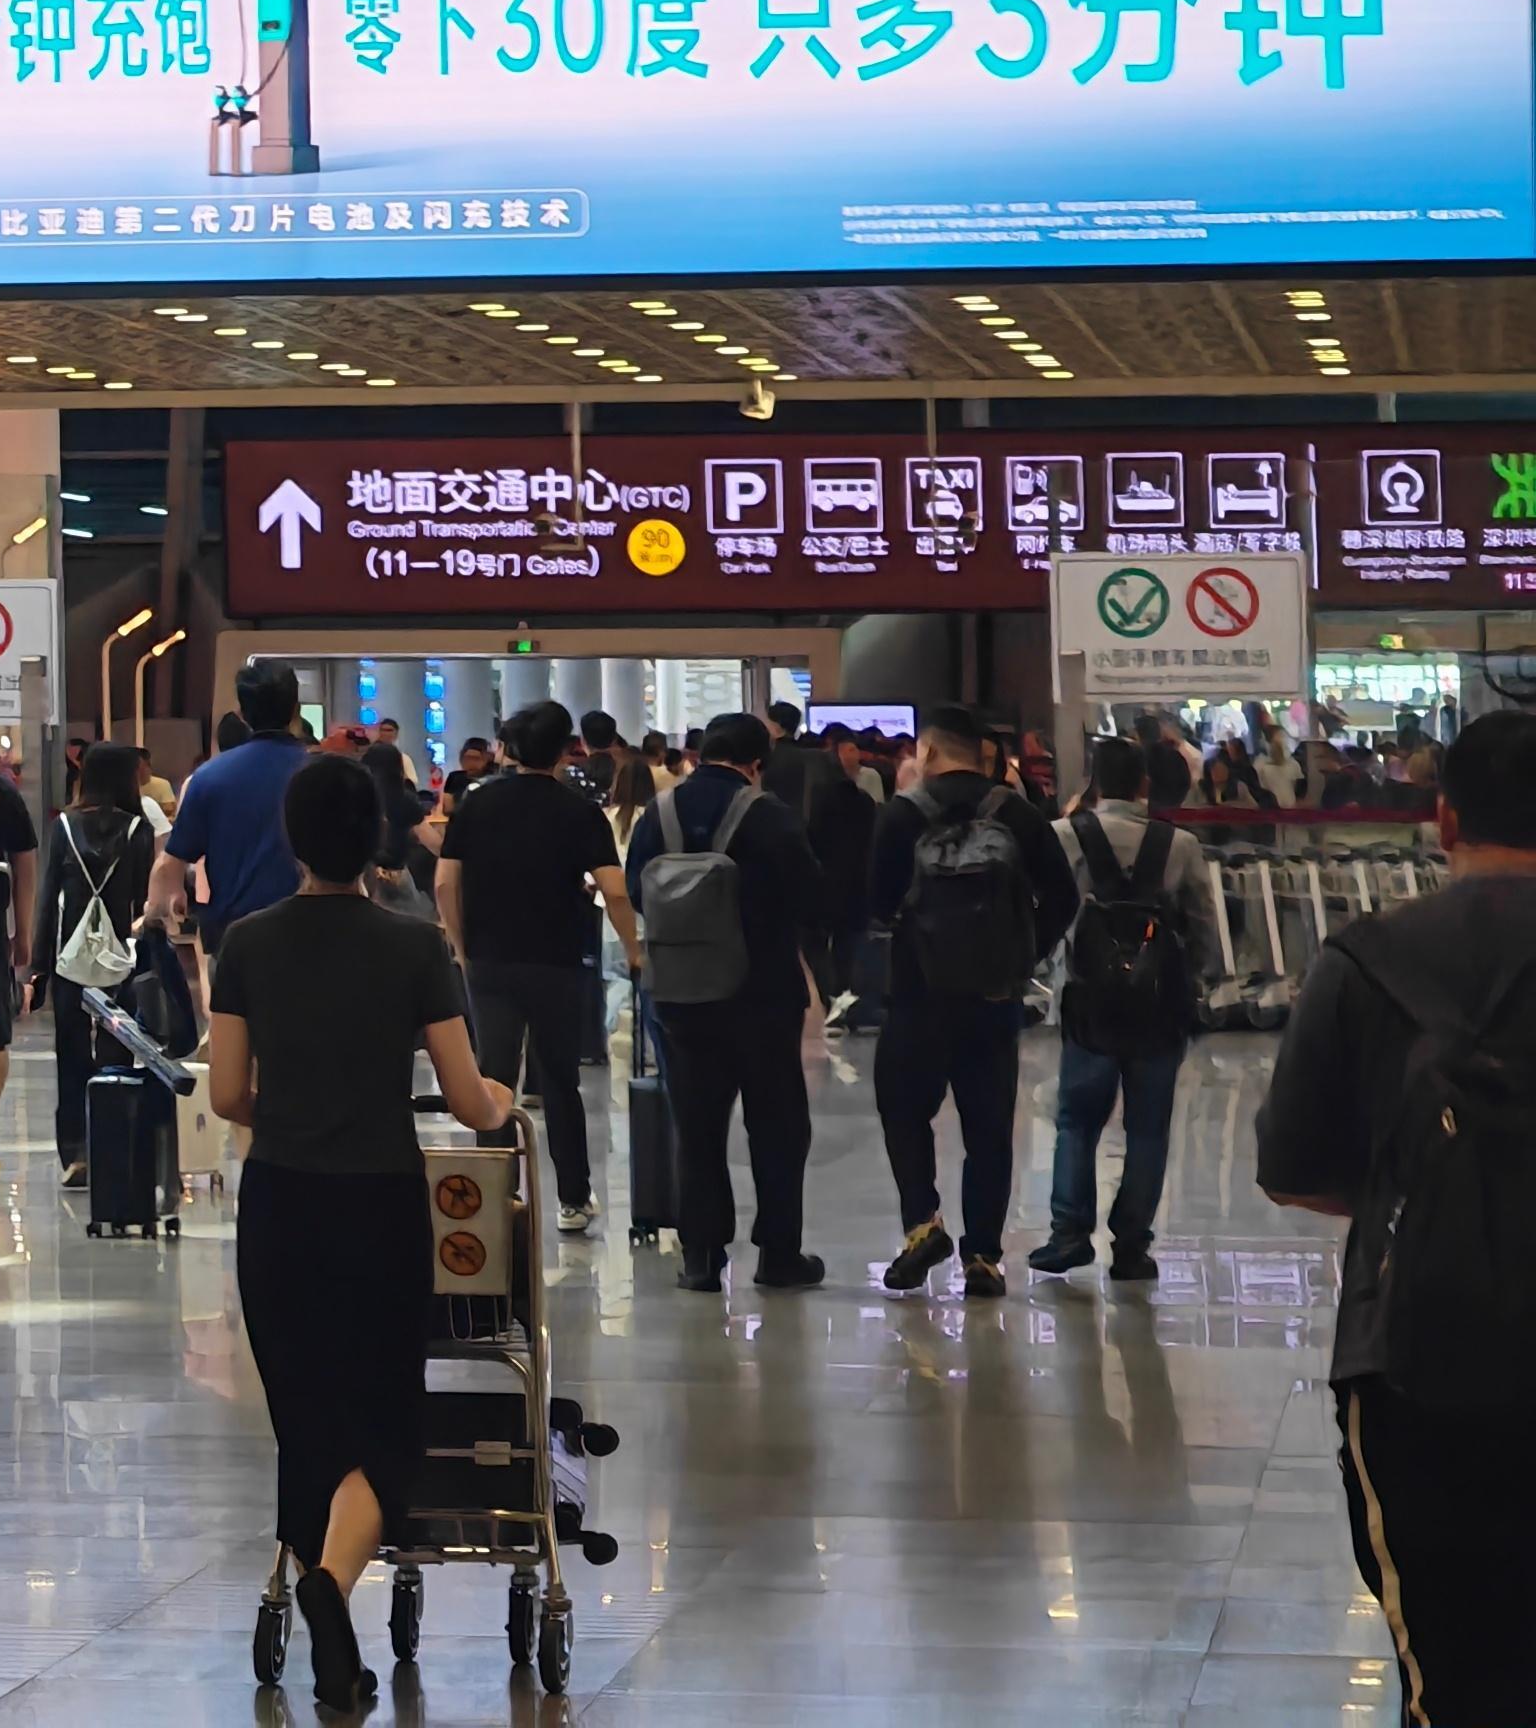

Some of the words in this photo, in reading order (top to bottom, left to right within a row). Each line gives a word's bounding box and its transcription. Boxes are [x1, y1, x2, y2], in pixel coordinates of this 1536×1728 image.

[0, 198, 571, 236] 比亚迪第二代刀片电池及闪充技术
[347, 520, 416, 538] Ground
